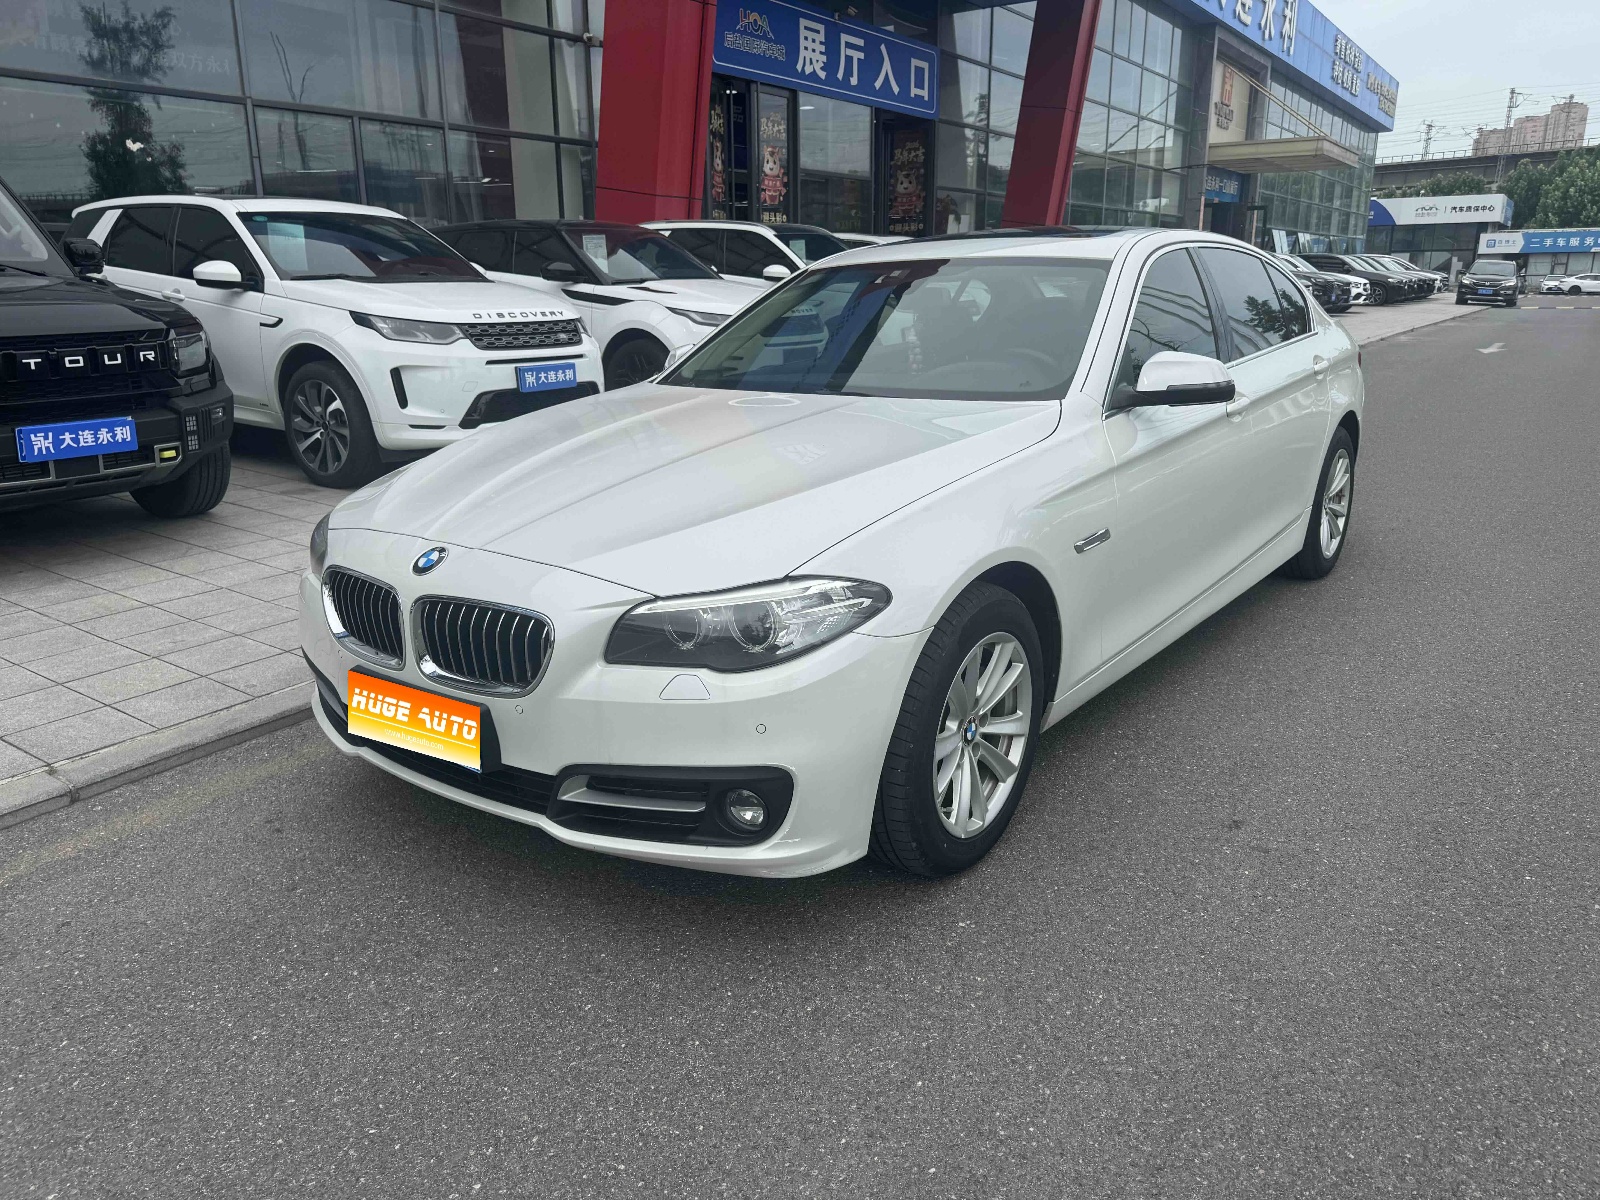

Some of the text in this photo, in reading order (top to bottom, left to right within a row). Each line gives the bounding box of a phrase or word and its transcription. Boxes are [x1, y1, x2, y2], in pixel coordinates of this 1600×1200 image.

[796, 17, 929, 101] 展厅入口
[1450, 204, 1495, 214] 汽车质保中心
[1530, 236, 1600, 248] 二手车服务
[472, 310, 565, 319] DISCOVERY
[22, 351, 155, 370] TOUR
[538, 369, 574, 384] 大连永利
[59, 426, 131, 449] 大连永利
